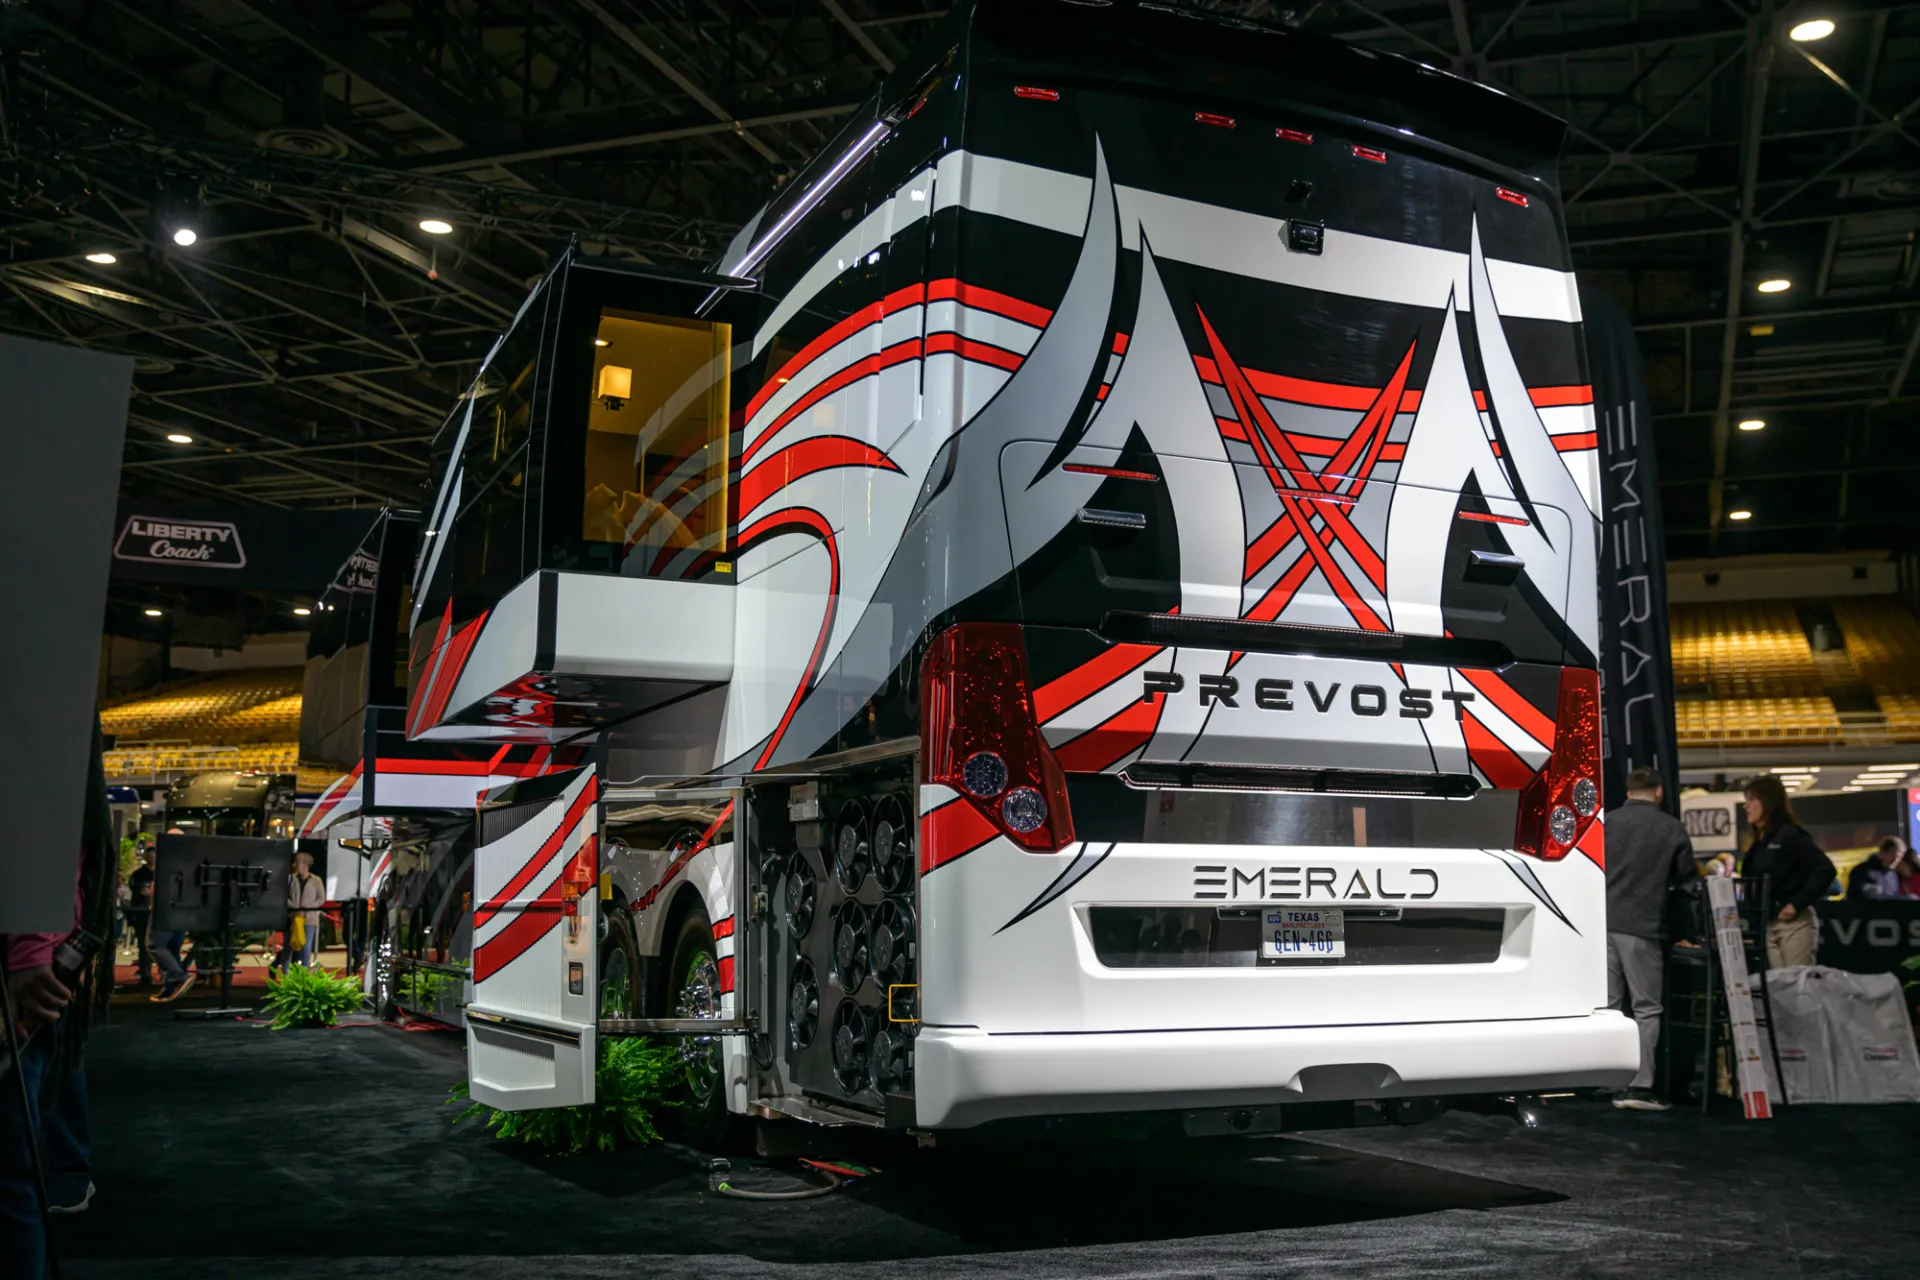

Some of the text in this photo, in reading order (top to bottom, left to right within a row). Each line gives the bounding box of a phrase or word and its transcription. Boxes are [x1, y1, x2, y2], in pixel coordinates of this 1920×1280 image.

[131, 521, 231, 542] LIBERTY
[149, 540, 210, 560] Coach
[1143, 670, 1476, 722] PREVOST
[1193, 865, 1439, 899] EMERALD
[1288, 912, 1320, 922] TEXAS
